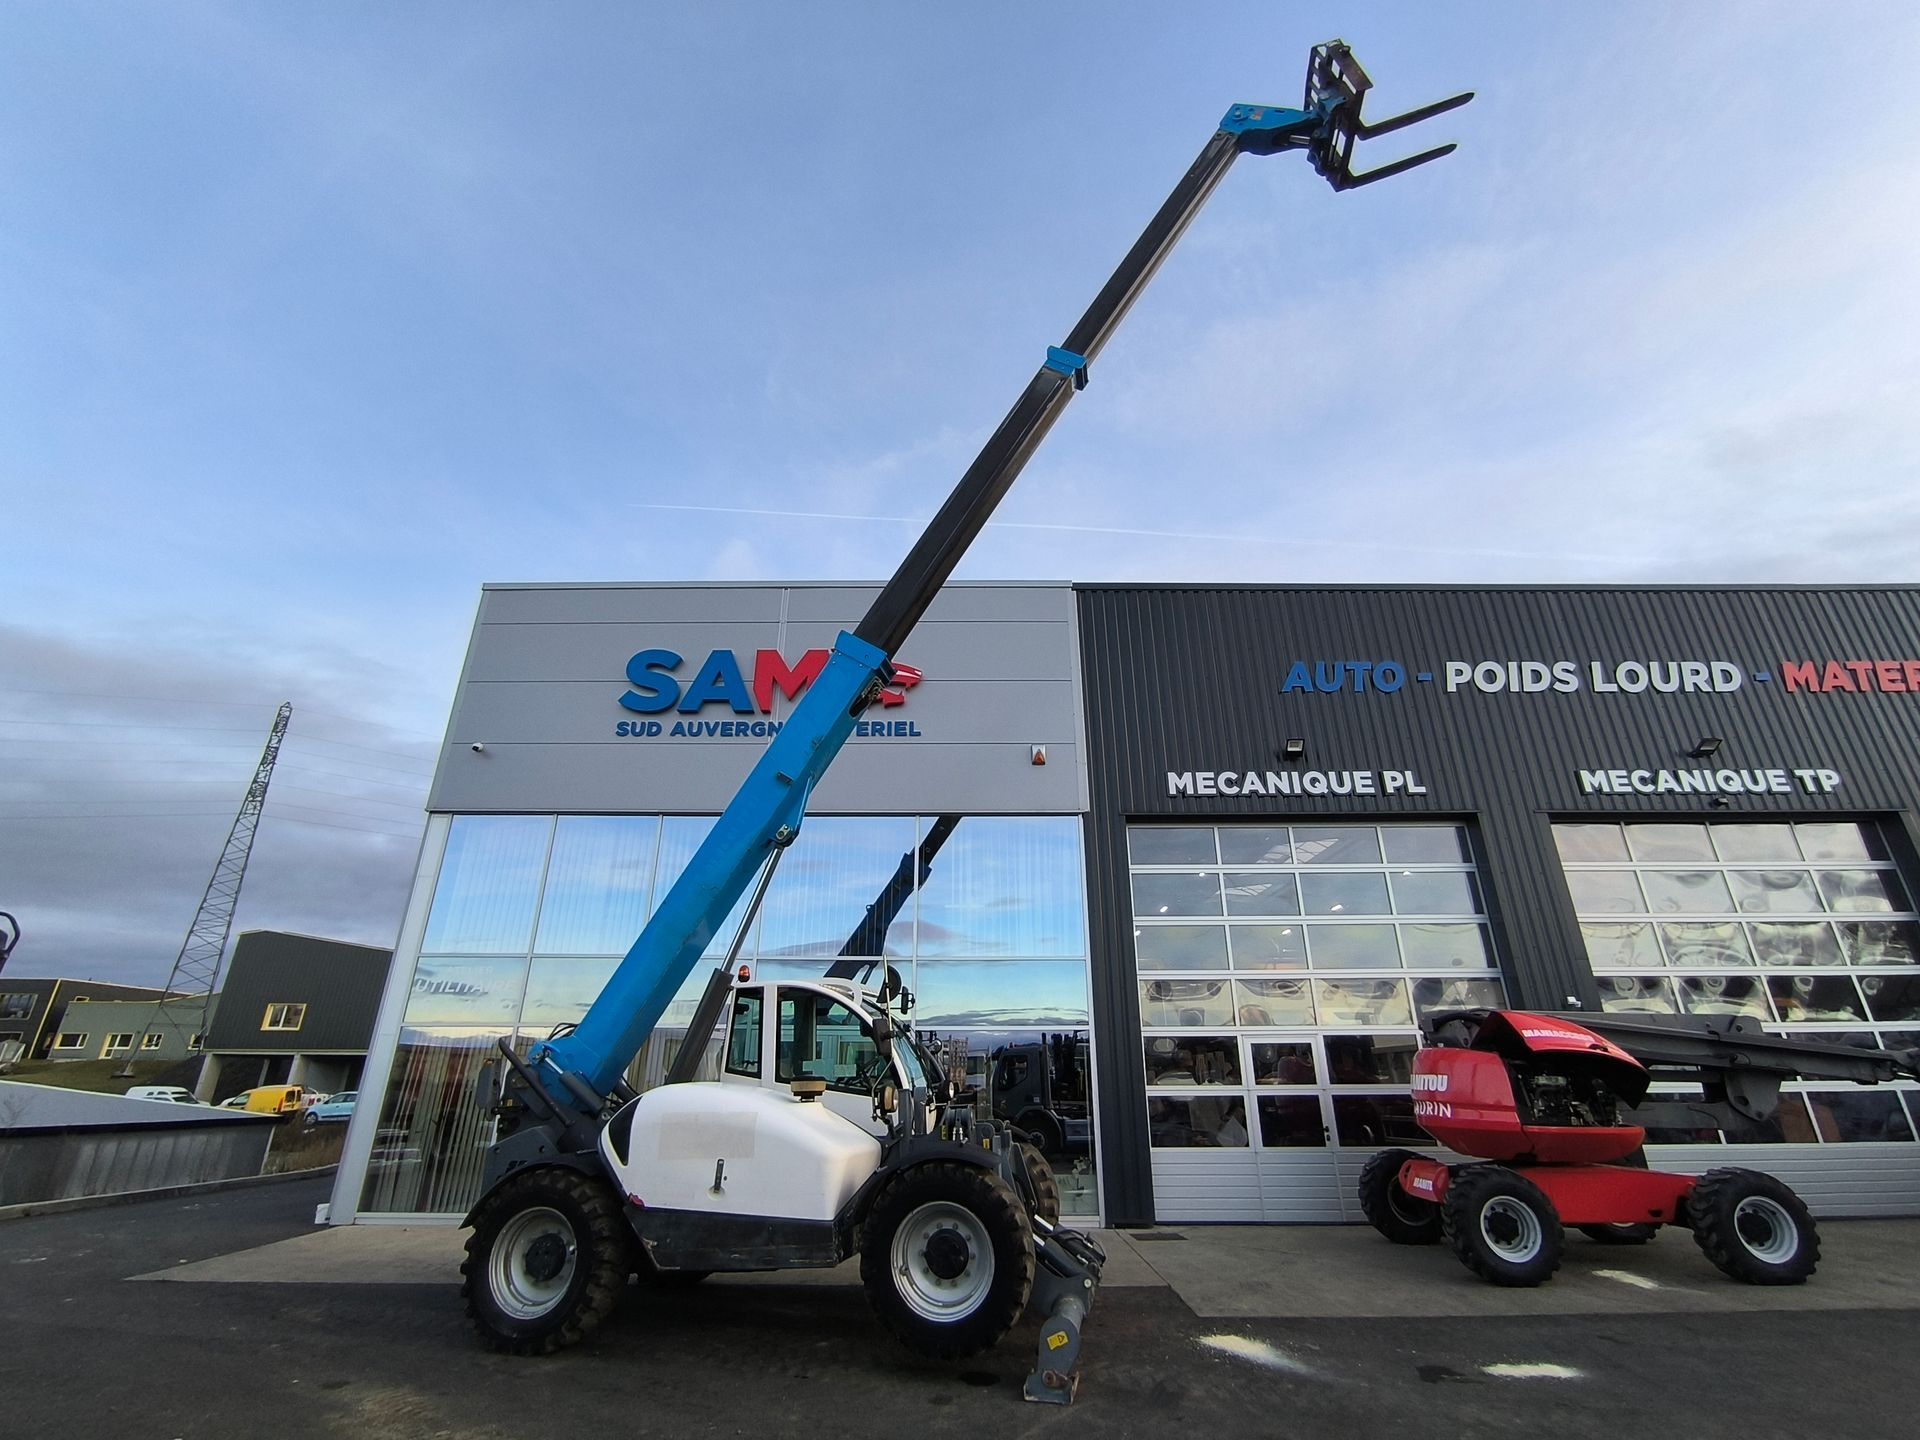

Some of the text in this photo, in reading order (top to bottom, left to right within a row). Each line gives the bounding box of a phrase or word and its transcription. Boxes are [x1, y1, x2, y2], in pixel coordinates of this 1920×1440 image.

[618, 649, 831, 714] SAM
[1281, 661, 1405, 693] AUTO
[1446, 660, 1579, 693] POIDS
[1591, 660, 1742, 693] LOURD
[616, 721, 921, 738] SUD AUVERGN ERIEL
[1167, 771, 1426, 796] MECANIQUE PL
[1578, 769, 1840, 794] MECANIQUE TP
[1414, 1101, 1452, 1118] AURIN
